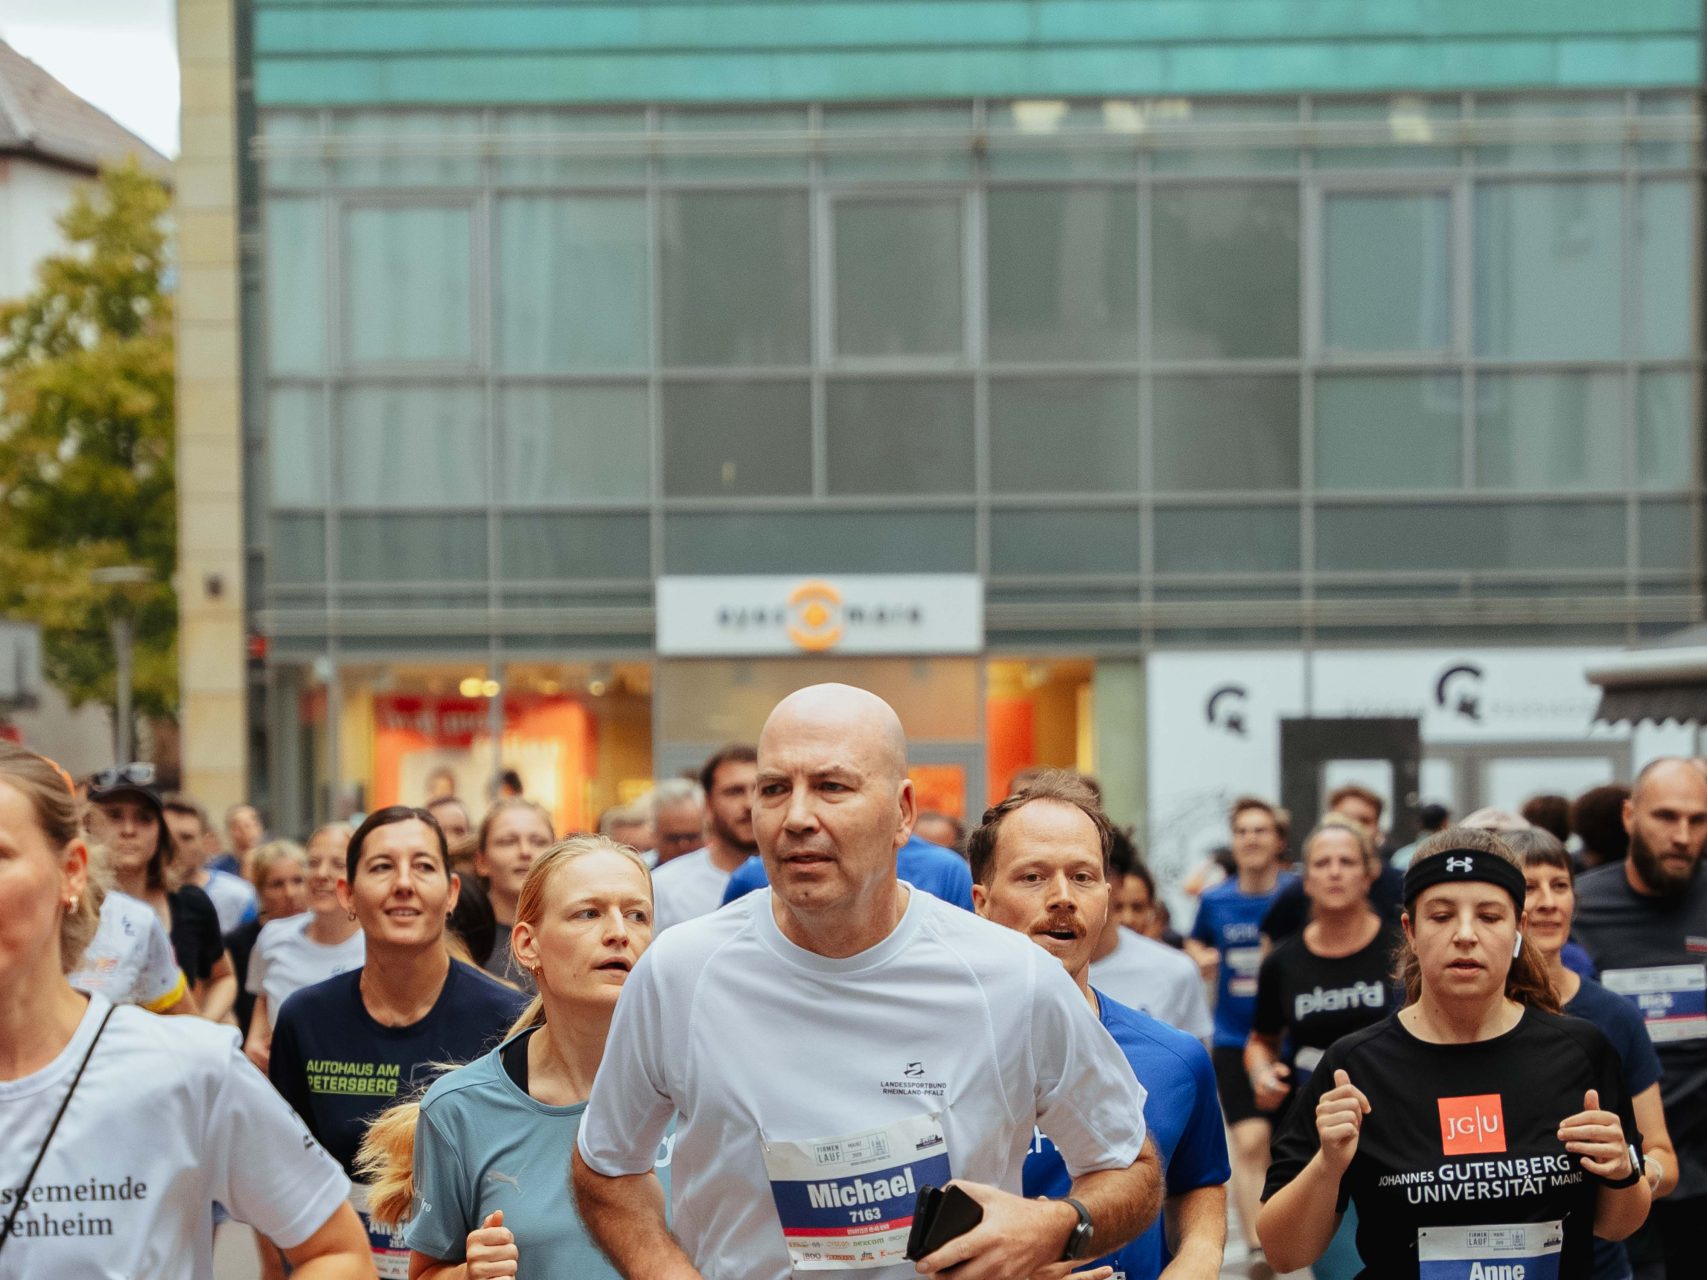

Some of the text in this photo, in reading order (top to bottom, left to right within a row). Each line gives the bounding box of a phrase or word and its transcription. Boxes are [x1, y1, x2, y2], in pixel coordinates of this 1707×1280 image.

[306, 1059, 400, 1077] AUTOHAUS AM
[307, 1075, 398, 1093] PETERSBERG
[880, 1081, 947, 1089] LANDESSPORTBUND
[882, 1088, 944, 1096] RHEINLAND-PFALZ
[818, 1152, 840, 1163] LAUF
[1378, 1154, 1570, 1186] JOHANNES GUTENBERG
[807, 1167, 916, 1208] Michael
[1407, 1171, 1583, 1204] UNIVERSITÄT MAINZ
[849, 1207, 881, 1223] 7163
[1, 1212, 113, 1237] enheim
[1469, 1237, 1487, 1246] LAUF
